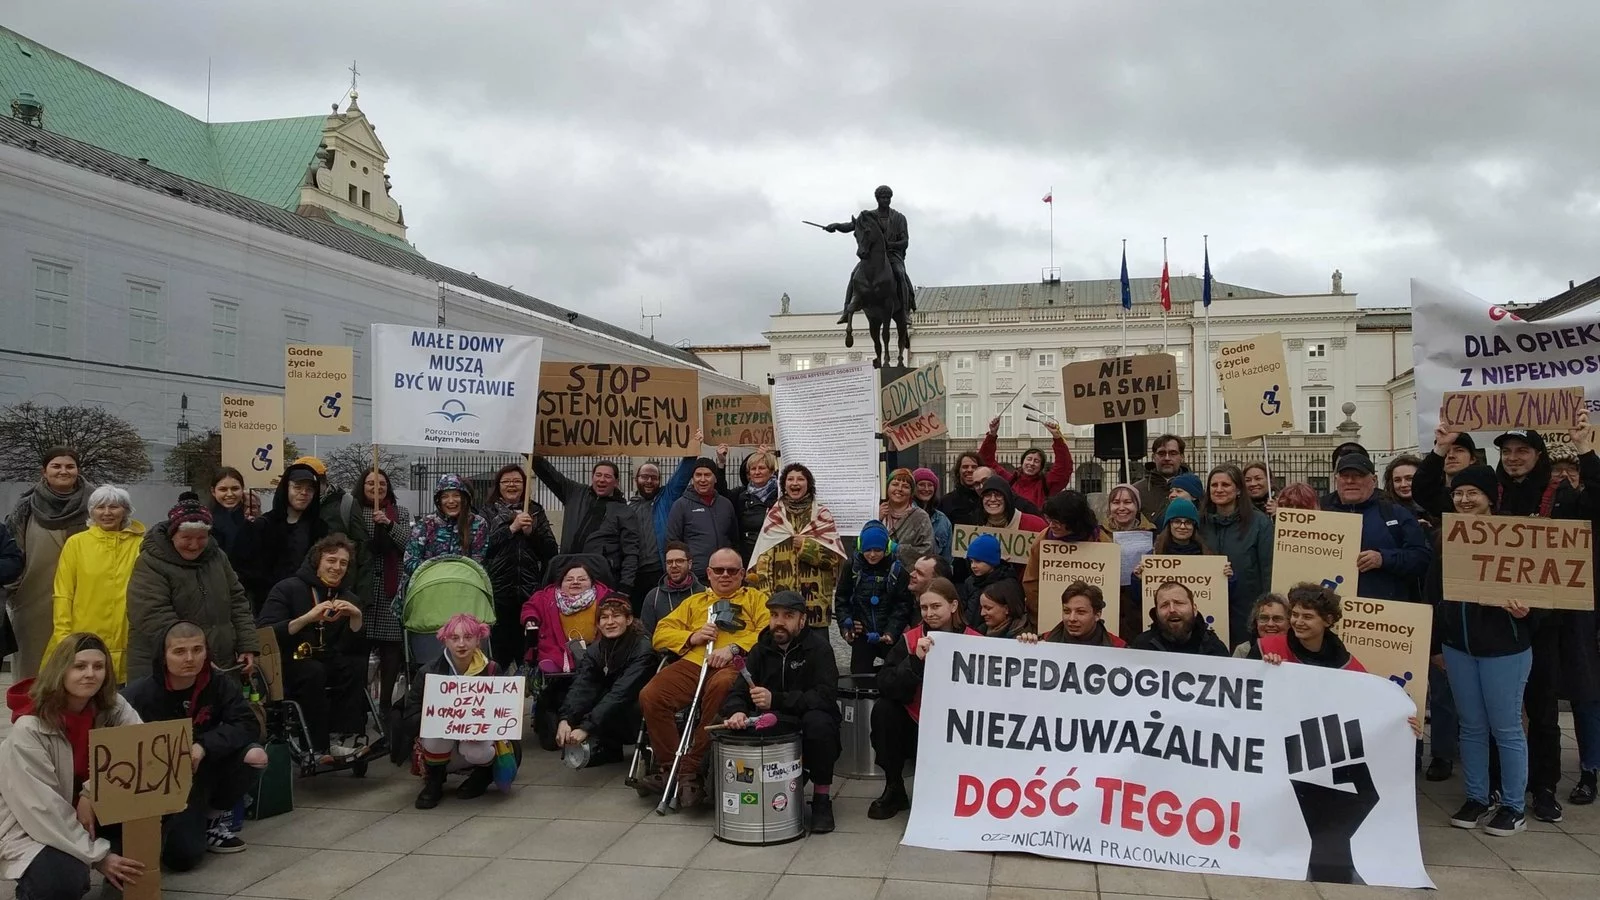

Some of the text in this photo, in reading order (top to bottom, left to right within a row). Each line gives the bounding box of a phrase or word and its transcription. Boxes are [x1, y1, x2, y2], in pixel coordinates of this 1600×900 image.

[411, 331, 505, 353] MAŁE DOMY
[1465, 322, 1600, 358] DLA OPIEK
[288, 347, 323, 357] Godne
[1221, 343, 1255, 355] Godne
[288, 358, 316, 368] życie
[429, 354, 483, 377] MUSZĄ
[1224, 356, 1250, 368] życie
[288, 370, 347, 381] dla każdego
[566, 363, 650, 394] STOP
[1225, 371, 1240, 380] dla
[1242, 362, 1281, 377] każdego
[1460, 355, 1600, 387] Z NIEPEŁNOS
[394, 372, 515, 397] BYĆ W USTAWIE
[1074, 381, 1112, 398] DLA
[223, 397, 255, 406] Godne
[536, 389, 688, 423] YSTEMOWEMU
[223, 409, 248, 418] życie
[1445, 389, 1582, 431] CZAS NA ZMIANY
[223, 421, 278, 432] dla każdego
[716, 411, 773, 426] PREZYDEN
[424, 428, 480, 437] Porozumienie
[424, 435, 454, 443] Autyzm
[540, 418, 690, 449] IEWOLNICTWU
[711, 426, 775, 444] MA ASYST
[1279, 512, 1316, 524] STOP
[1278, 528, 1345, 544] przemocy
[1447, 520, 1592, 549] ASYSTENT
[1043, 543, 1078, 554] STOP
[1277, 540, 1344, 560] finansowej
[1042, 559, 1105, 572] przemocy
[1144, 558, 1182, 569] STOP
[1471, 554, 1587, 588] TERAZ
[1042, 571, 1105, 586] finansowej
[1145, 575, 1212, 586] przemocy
[1343, 600, 1385, 615] STOP
[1342, 618, 1415, 637] przemocy
[1341, 631, 1413, 654] finansowej
[951, 650, 1264, 711] NIEPEDAGOGICZNE
[453, 696, 485, 707] OZN
[426, 704, 435, 717] W
[494, 707, 512, 718] NIE
[444, 720, 492, 736] ŚMIEJE
[946, 708, 1265, 774] NIEZAUWAŻALNE
[953, 766, 1241, 850] DOŚĆ TEGO!
[1100, 839, 1222, 869] PRACOWNICZA
